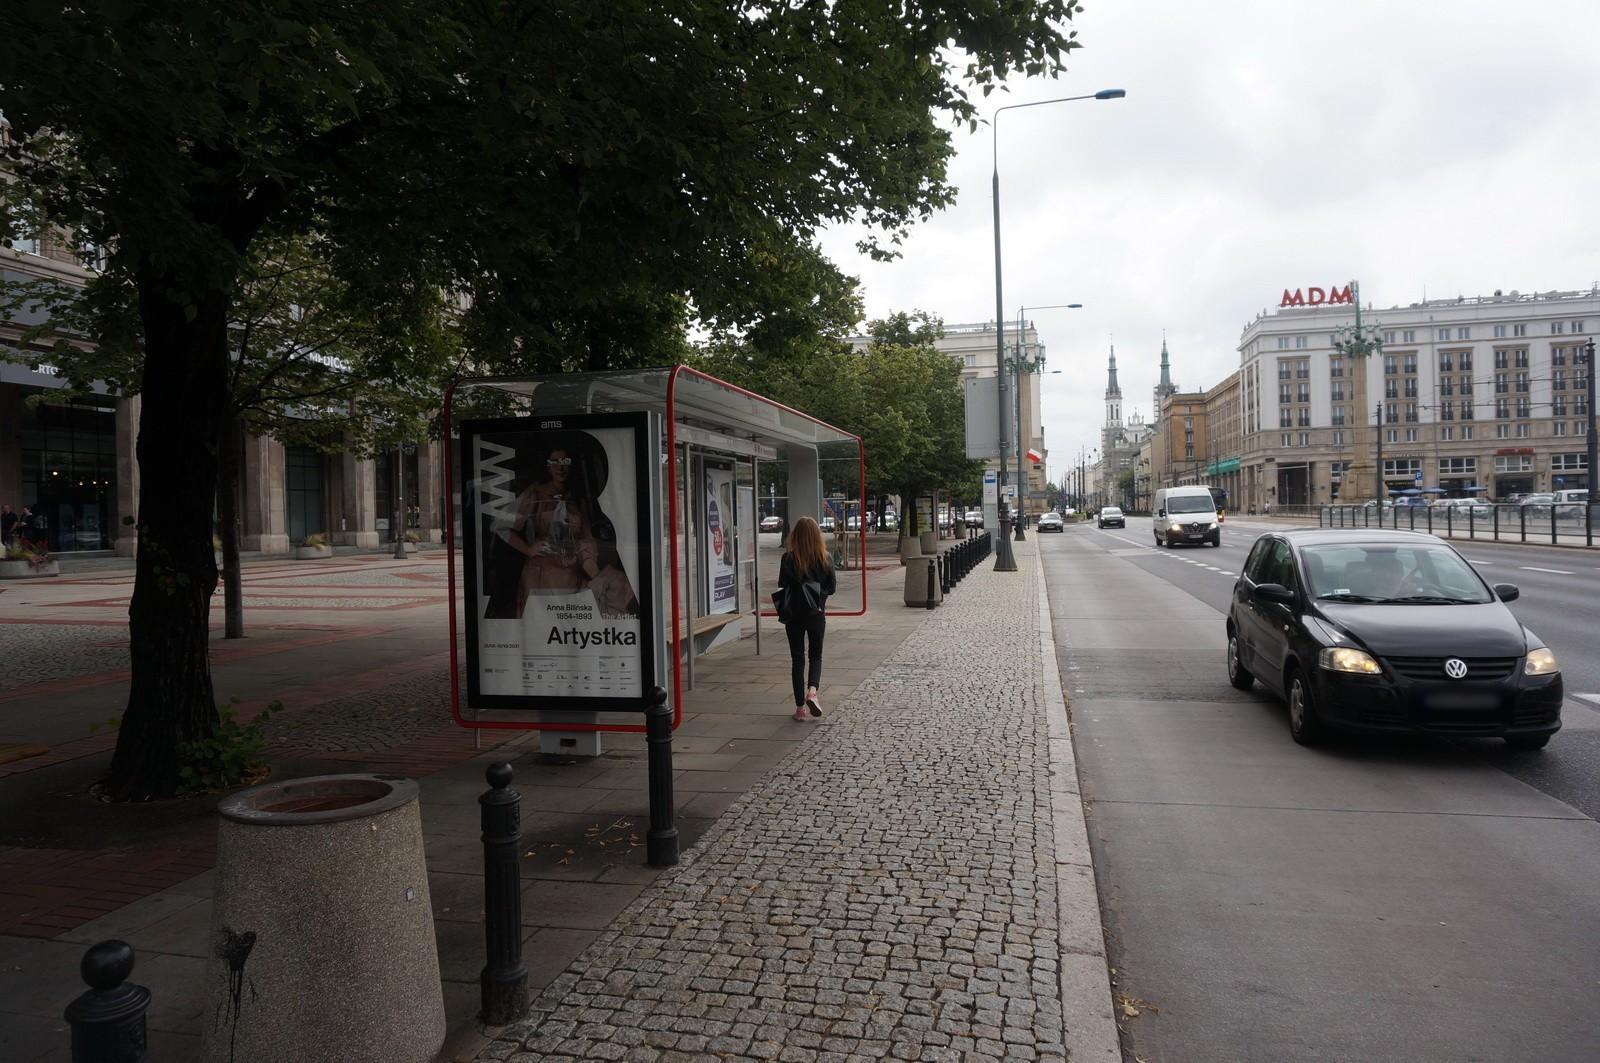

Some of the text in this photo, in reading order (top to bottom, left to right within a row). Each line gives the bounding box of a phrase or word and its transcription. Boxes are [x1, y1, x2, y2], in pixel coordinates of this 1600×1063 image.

[1280, 285, 1354, 308] MDM
[540, 420, 563, 429] ams
[547, 626, 637, 649] Artystka
